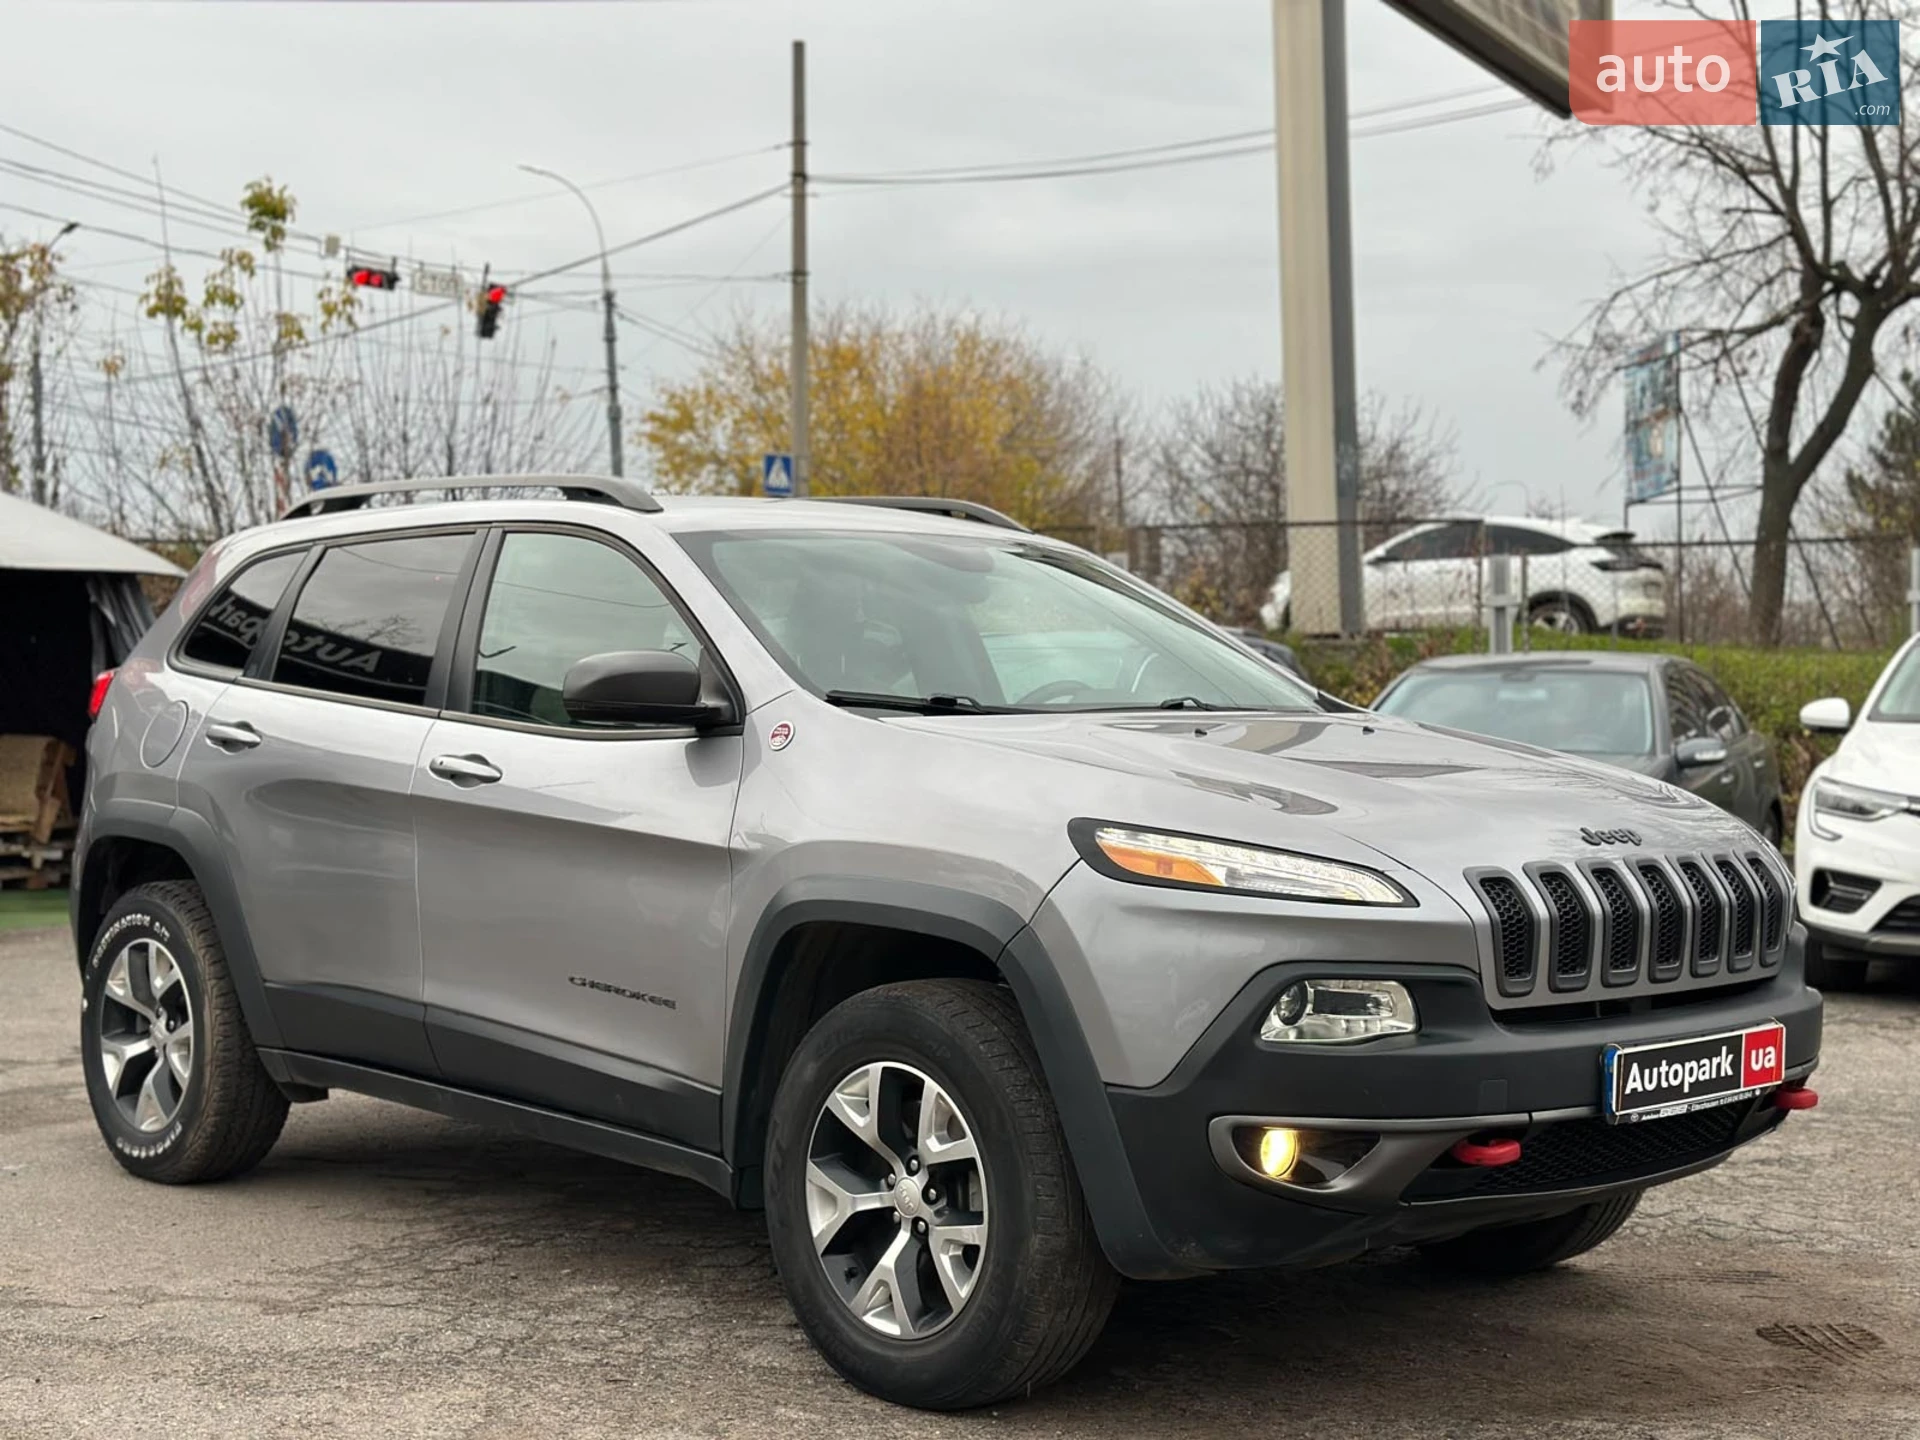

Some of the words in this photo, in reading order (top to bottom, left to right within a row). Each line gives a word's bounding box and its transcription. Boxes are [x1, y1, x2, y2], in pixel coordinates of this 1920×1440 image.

[1580, 827, 1642, 847] Jeep
[568, 976, 676, 1010] CHEROKEE
[1624, 1046, 1734, 1094] Autopark
[1751, 1046, 1776, 1071] ua
